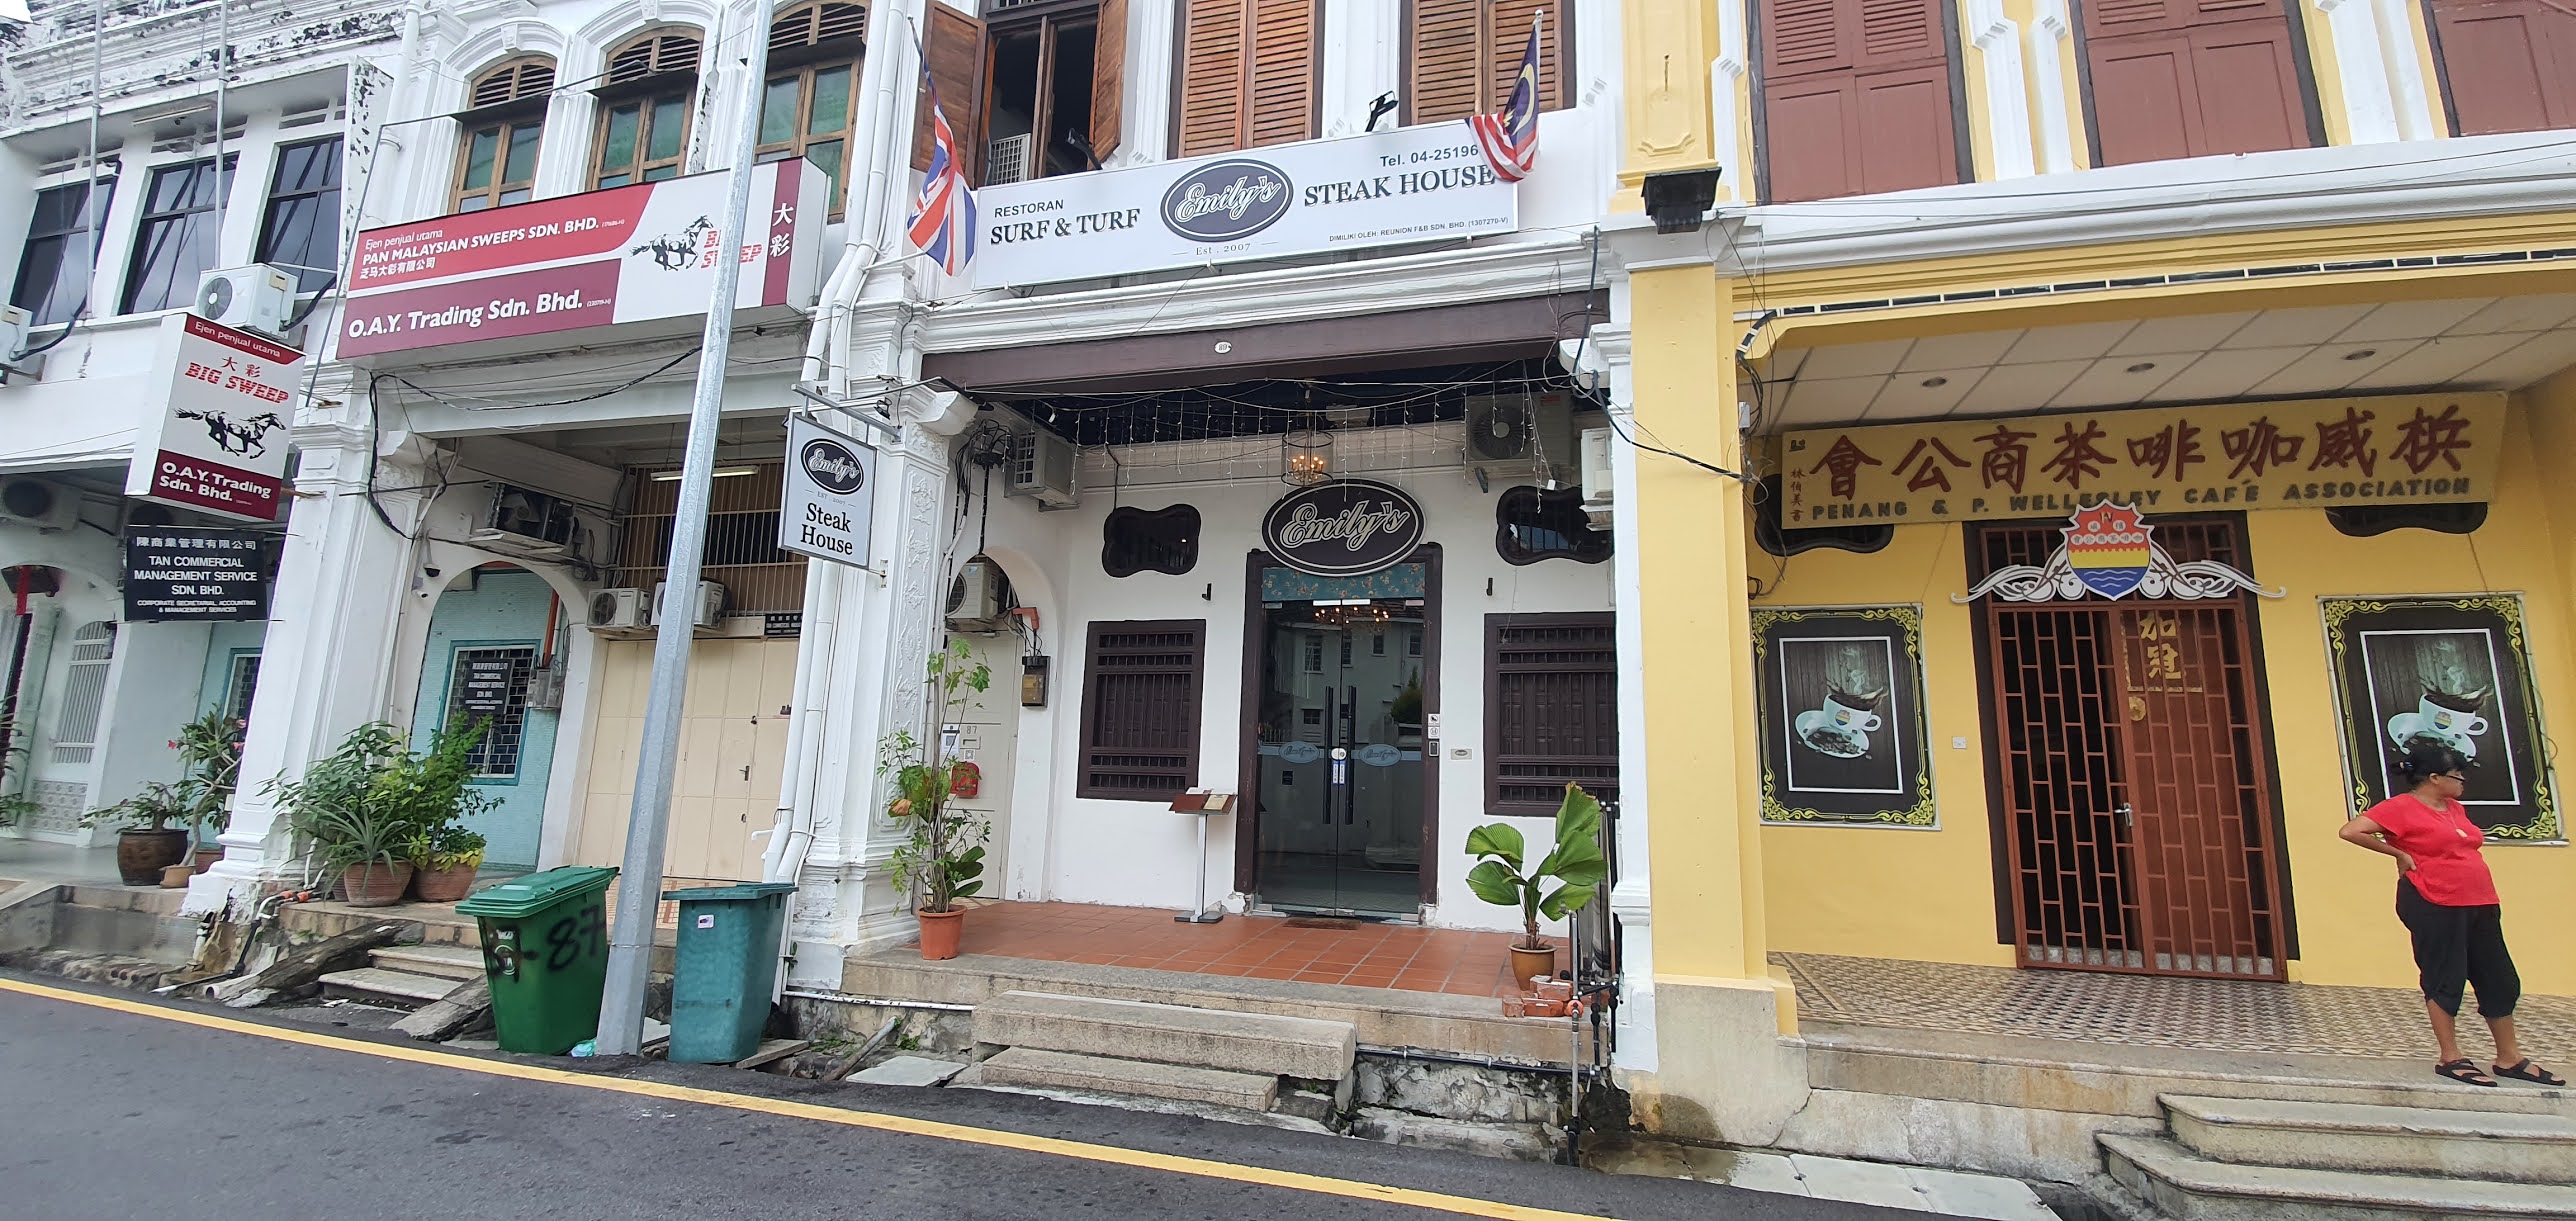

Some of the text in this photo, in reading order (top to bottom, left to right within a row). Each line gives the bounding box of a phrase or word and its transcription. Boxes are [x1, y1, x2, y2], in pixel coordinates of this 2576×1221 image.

[1380, 144, 1479, 167] Tel. 04-25196
[1174, 175, 1282, 223] Emily's
[1304, 164, 1496, 207] STEAK HOUSE
[994, 199, 1064, 218] RESTORAN
[362, 251, 389, 266] PAN
[391, 237, 469, 260] MALAYSIAN
[471, 228, 526, 248] SWEEPS
[528, 222, 561, 239] SDN.
[564, 216, 599, 233] BHD.
[365, 229, 443, 251] Ejen penjual utama
[769, 202, 794, 258] 大彩
[990, 208, 1141, 245] SURF & TURF
[1357, 231, 1379, 239] OLEH:
[1381, 226, 1413, 236] REUNION
[1449, 221, 1467, 229] BHD.
[1468, 217, 1509, 228] (1307270-V)
[701, 244, 763, 269] SEP
[1223, 243, 1251, 253] 2007
[348, 313, 402, 338] O.A.Y.
[407, 305, 485, 328] Trading
[487, 299, 530, 320] Sdn.
[536, 289, 583, 314] Bhd.
[195, 320, 281, 358] Ejen penjual utama
[185, 362, 289, 404] BIG SWEEP
[221, 356, 261, 378] 大彩
[162, 461, 272, 499] O.A.Y. Trading
[807, 447, 860, 483] Emily's
[159, 475, 233, 501] Sdn. Bhd.
[1812, 501, 1908, 520] PENANG
[1931, 499, 1949, 515] &
[1972, 498, 1990, 513] P.
[2009, 489, 2162, 511] WELLESLEY
[2283, 477, 2471, 501] ASSOCIATION
[806, 502, 852, 533] Steak
[1280, 500, 1411, 551] Emily's
[800, 523, 853, 556] House
[134, 569, 258, 581] MANAGEMENT SERVICE
[148, 555, 244, 568] TAN COMMERCIAL
[171, 585, 225, 595] SDN. BHD.
[966, 726, 978, 735] 87
